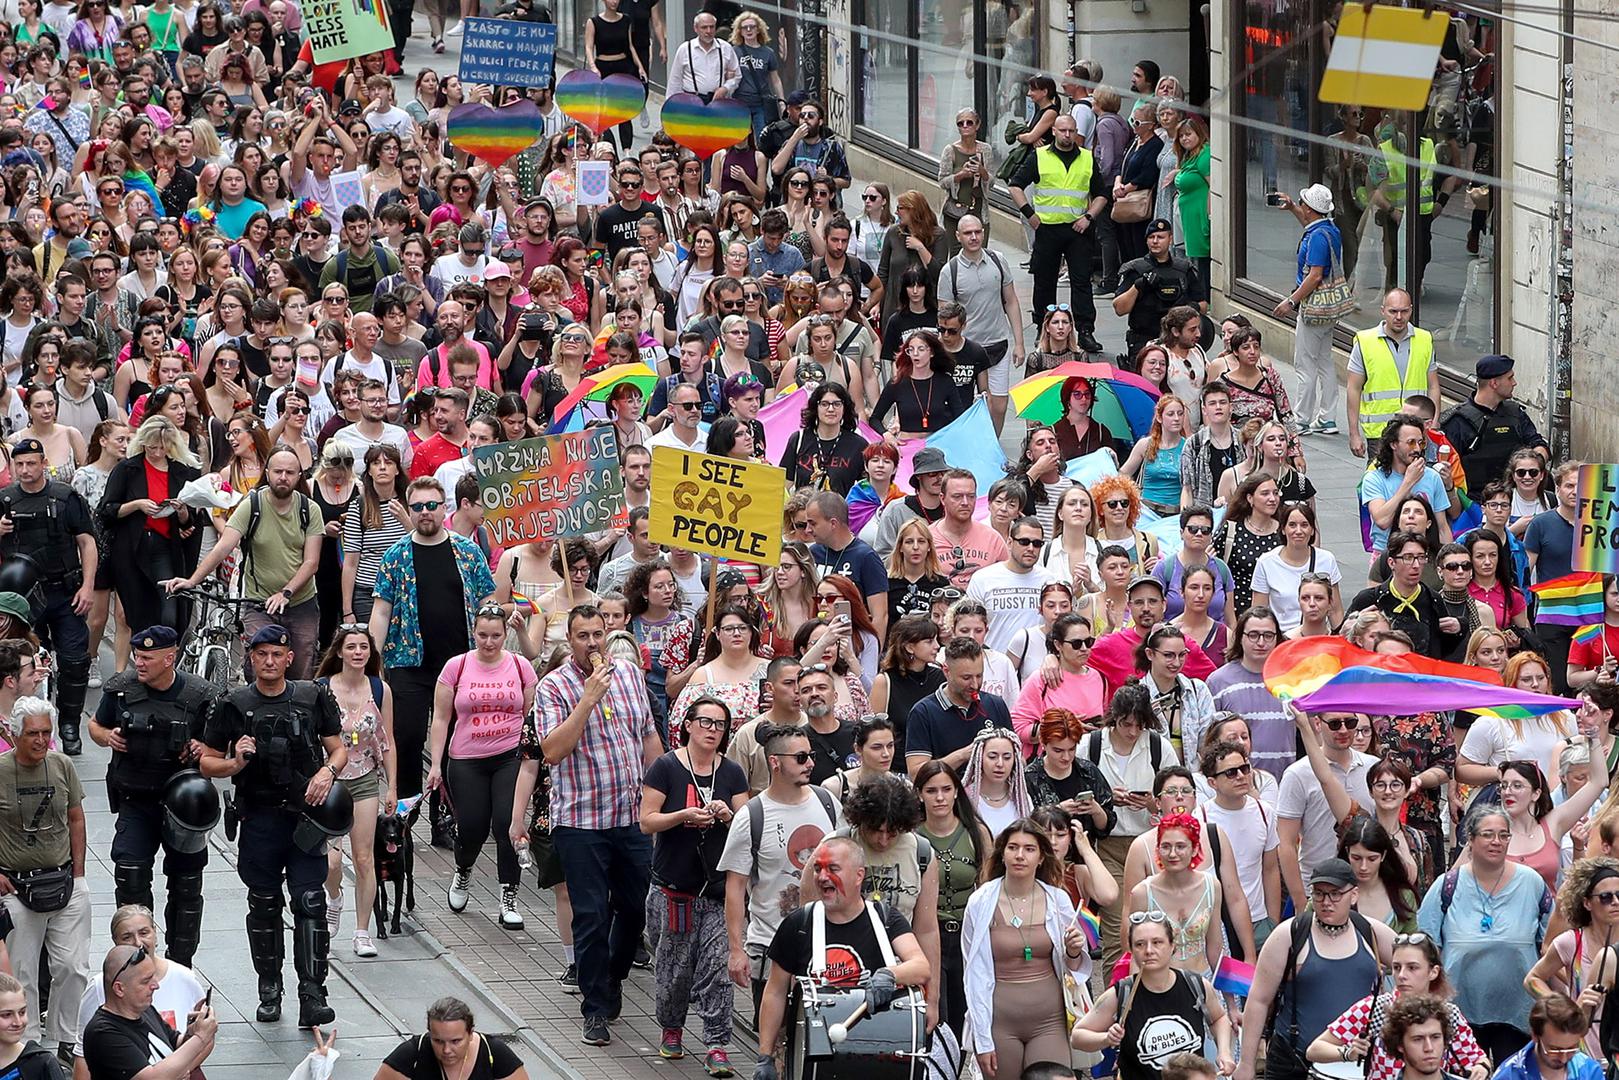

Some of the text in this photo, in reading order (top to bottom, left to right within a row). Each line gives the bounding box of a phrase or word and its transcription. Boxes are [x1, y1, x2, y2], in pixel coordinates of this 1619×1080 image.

[303, 2, 342, 19] LOVE
[307, 16, 344, 34] LESS
[515, 27, 527, 37] JE
[311, 31, 349, 50] HATE
[462, 54, 477, 65] NA
[508, 57, 540, 71] PEDER
[542, 62, 550, 72] A
[461, 71, 468, 80] U
[565, 431, 618, 465] NIJE
[682, 454, 747, 489] I SEE
[673, 480, 752, 524] GAY
[672, 515, 768, 558] PEOPLE
[966, 548, 989, 561] ZONE
[993, 596, 1026, 611] PUSSY
[470, 681, 504, 690] pussy
[471, 726, 512, 740] pozdravy
[1151, 1031, 1177, 1044] DRUM
[1161, 1035, 1187, 1049] BIJES
